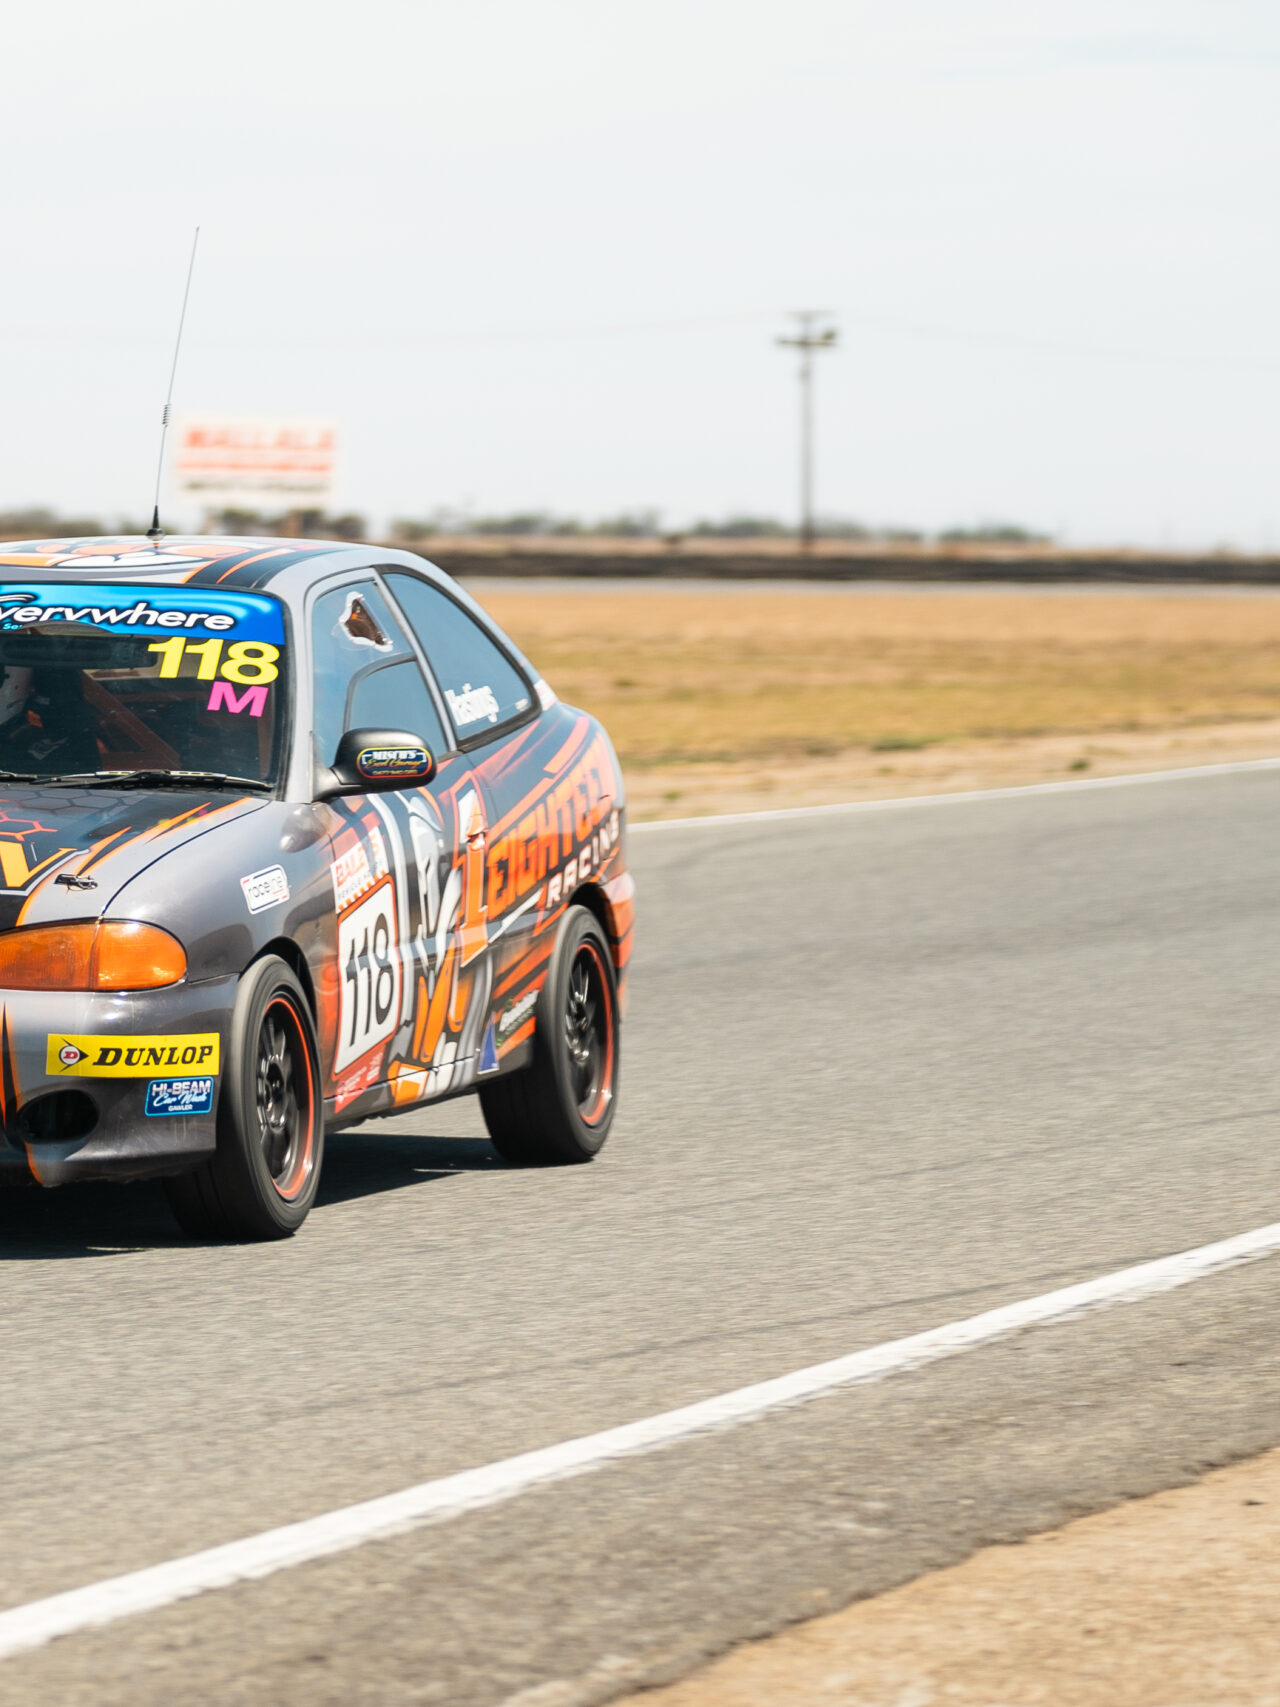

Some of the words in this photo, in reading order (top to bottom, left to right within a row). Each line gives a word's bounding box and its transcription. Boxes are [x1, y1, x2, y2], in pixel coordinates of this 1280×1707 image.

[147, 636, 280, 685] 118
[207, 681, 269, 717] M
[346, 913, 395, 1048] 118
[92, 1045, 214, 1067] DUNLOP
[152, 1080, 211, 1096] HI-BEAM
